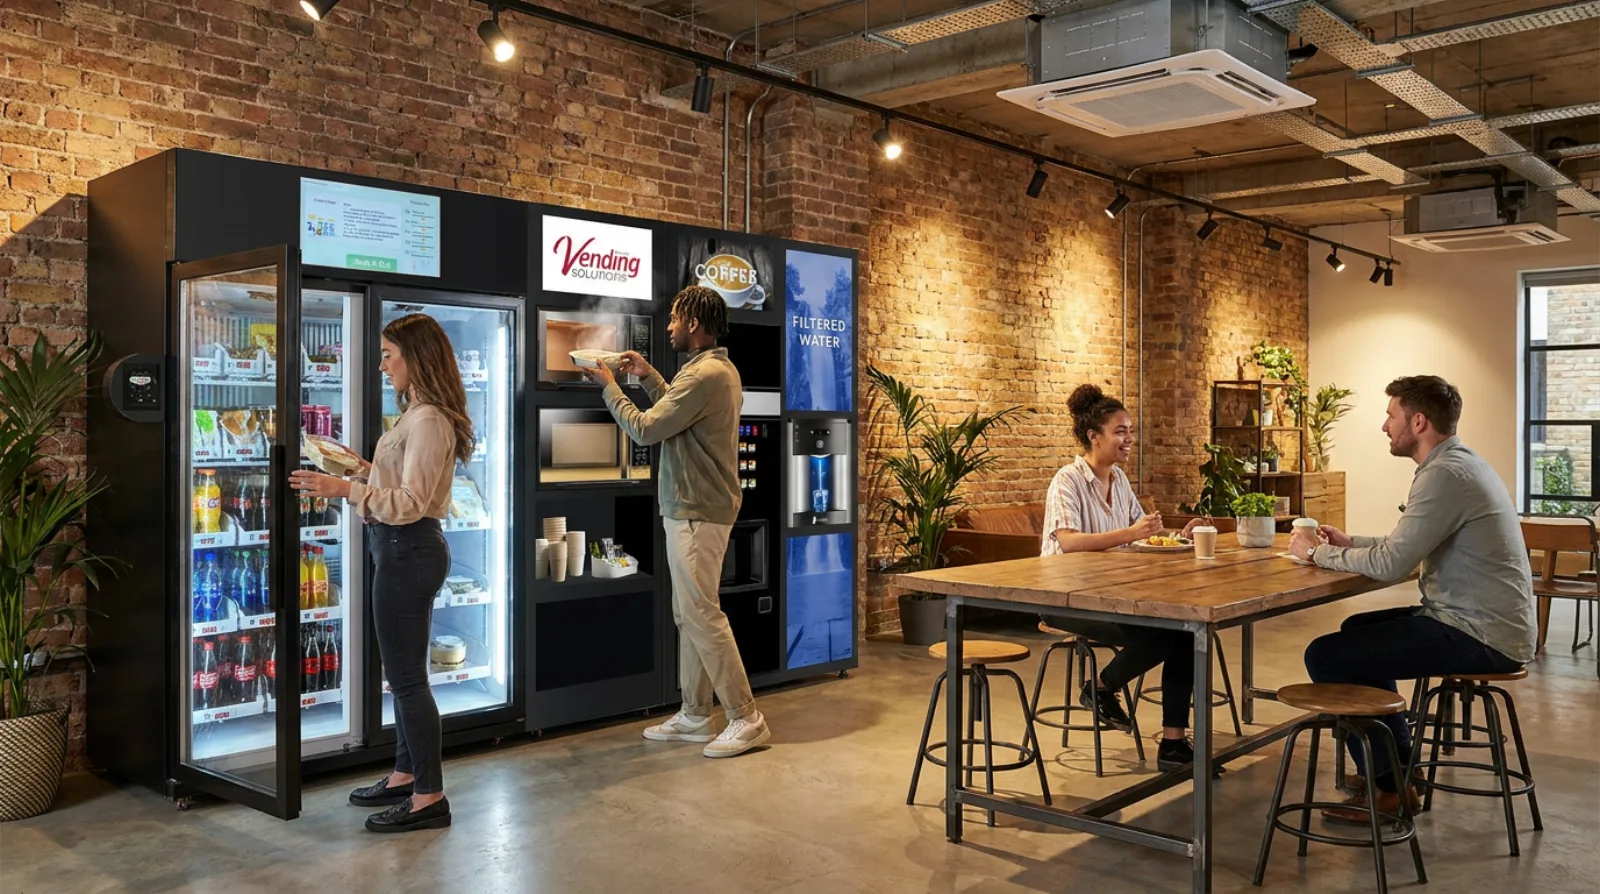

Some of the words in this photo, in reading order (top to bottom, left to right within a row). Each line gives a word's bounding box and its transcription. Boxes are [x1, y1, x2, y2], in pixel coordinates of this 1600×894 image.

[553, 235, 641, 278] Vending
[792, 315, 846, 332] FILTERED
[799, 333, 840, 349] WATER
